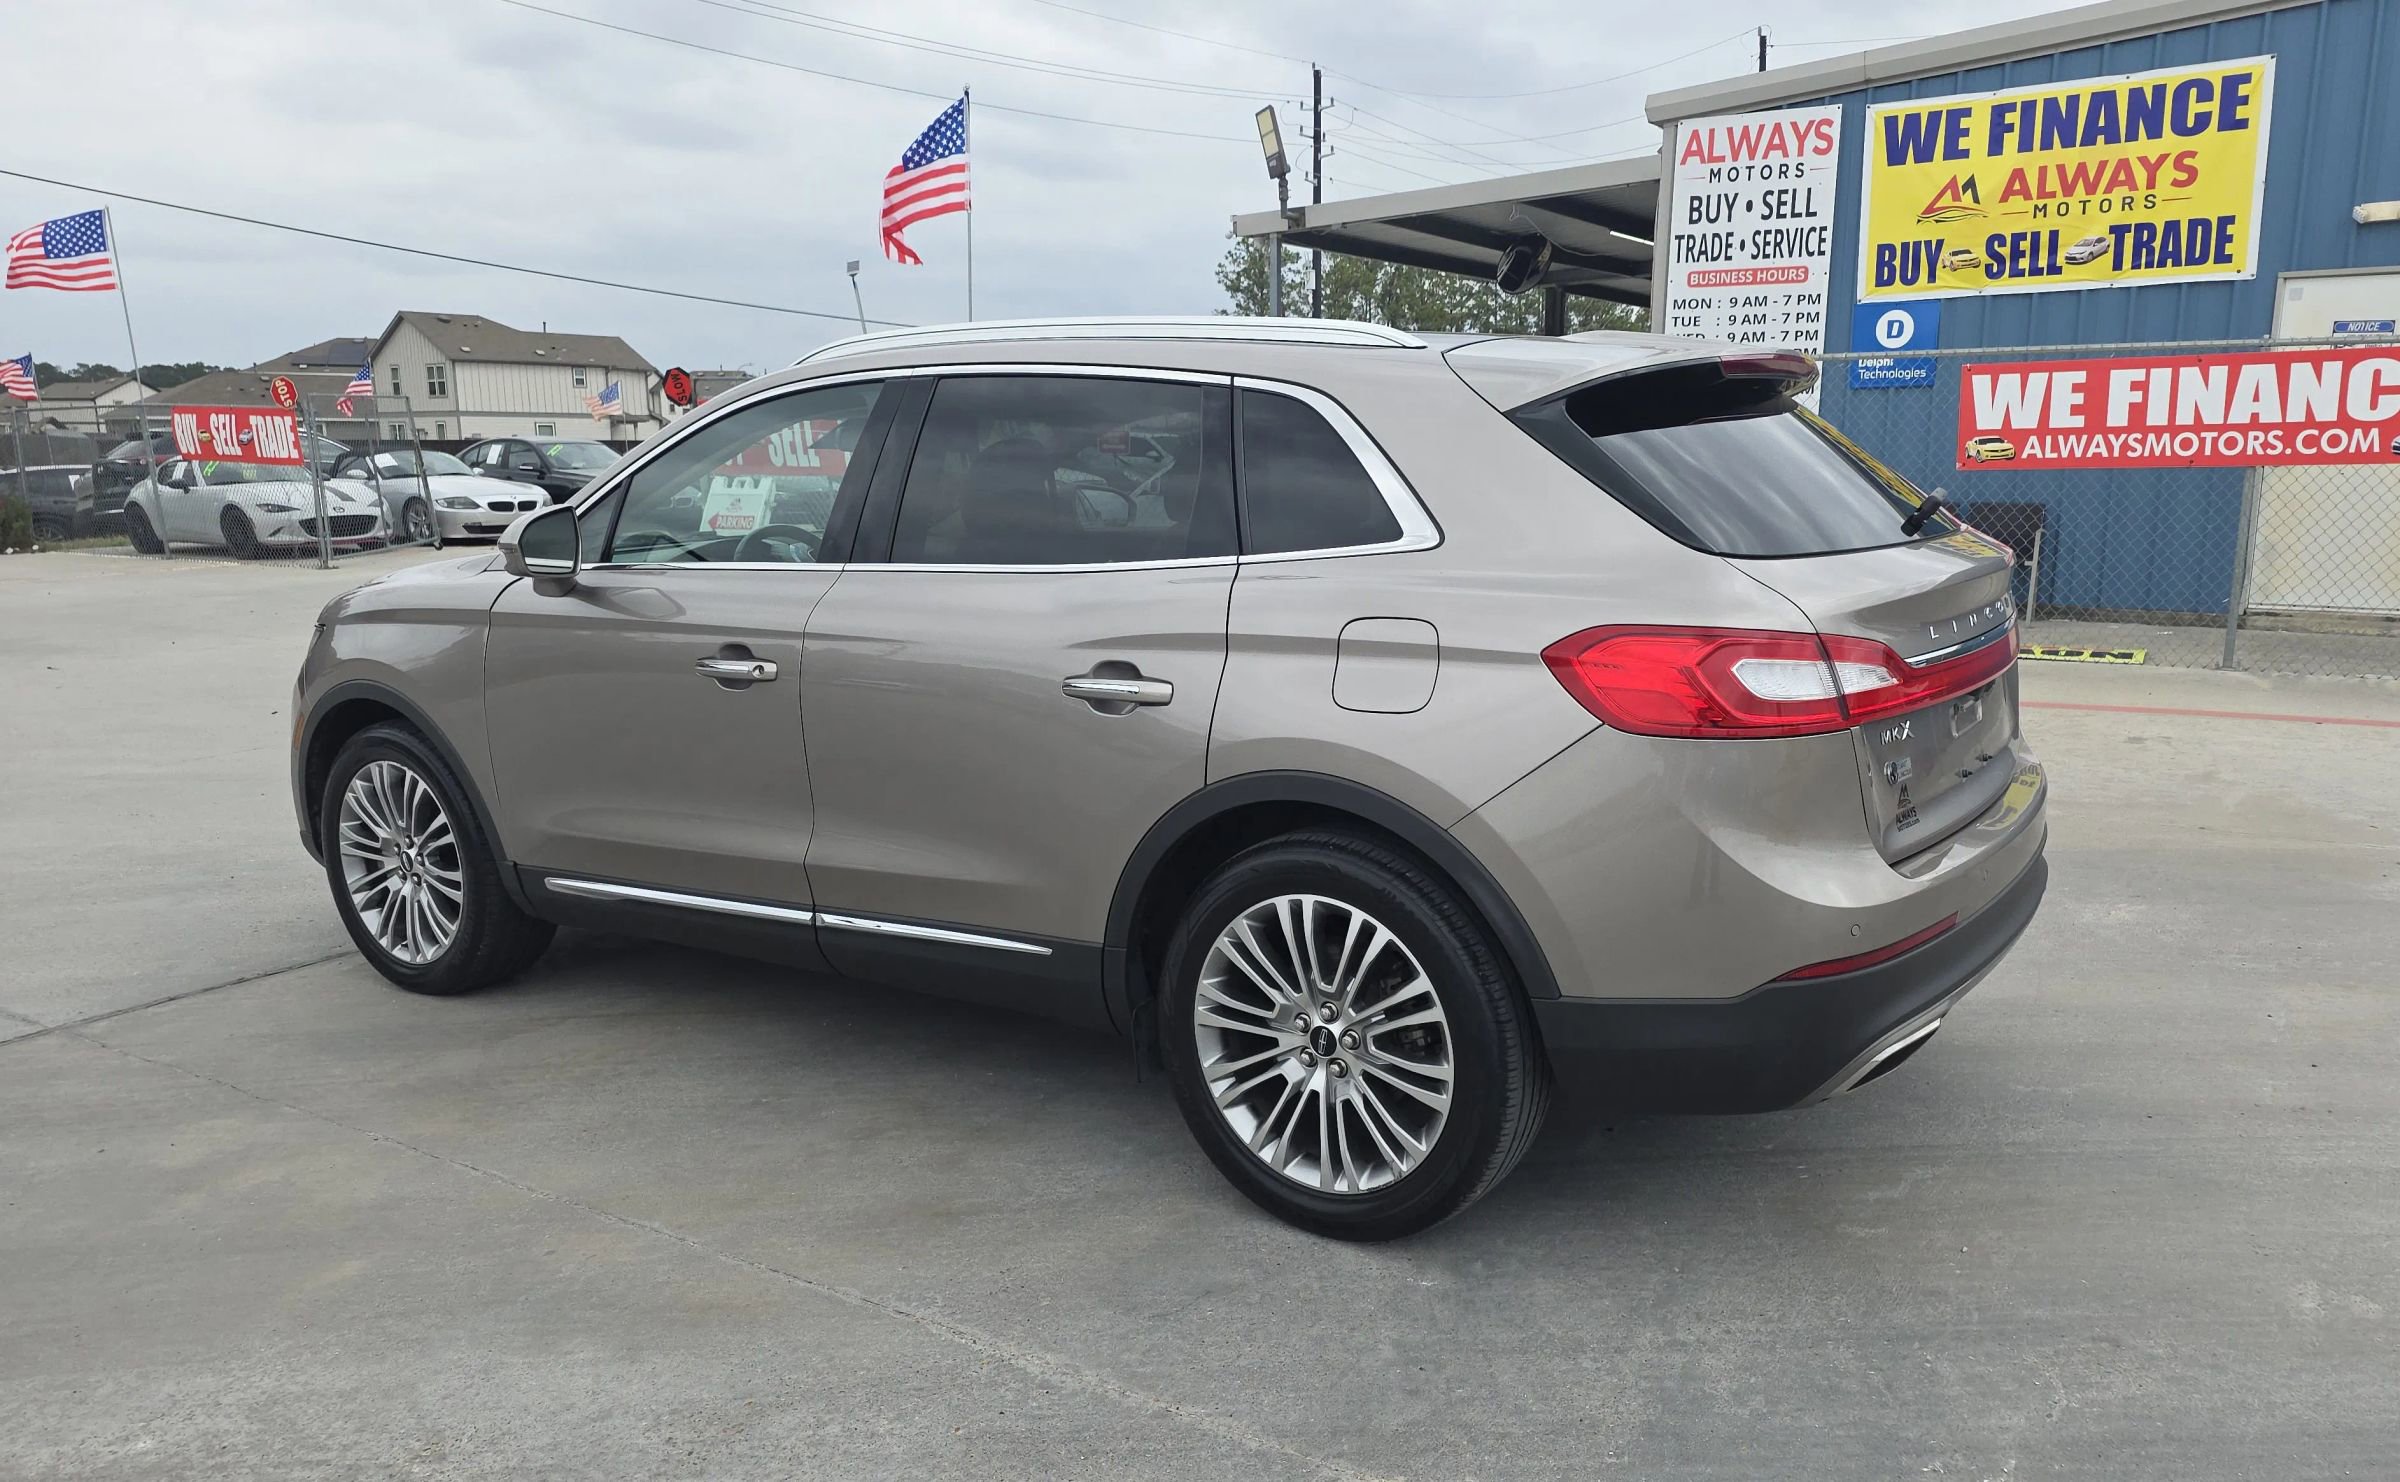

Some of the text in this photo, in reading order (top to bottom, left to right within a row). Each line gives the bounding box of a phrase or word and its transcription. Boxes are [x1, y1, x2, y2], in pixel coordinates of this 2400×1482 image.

[1883, 72, 2253, 167] WE FINANCE
[1680, 118, 1834, 166] ALWAYS
[1709, 162, 1805, 183] MOTORS
[1998, 149, 2199, 203] ALWAYS
[1688, 187, 1817, 225] BUY SELL
[2032, 193, 2157, 219] MOTORS
[1675, 226, 1828, 263] TRADE SERVICE
[1875, 215, 2237, 288] BUY SELL TRADE
[1690, 268, 1805, 285] BUSINESS HOURS
[1673, 298, 1712, 310] MON
[1729, 297, 1738, 308] 9
[1742, 295, 1768, 307] AM
[1782, 295, 1792, 306] 7
[1797, 293, 1822, 306] PM
[1671, 315, 1702, 327] TUE
[1728, 314, 1737, 326] 9
[1741, 313, 1767, 325] AM
[1781, 313, 1791, 324] 7
[1795, 311, 1820, 323] PM
[2347, 321, 2381, 332] NOTICE
[1727, 332, 1736, 343] 9
[1740, 331, 1766, 343] AM
[1780, 330, 1790, 342] 7
[1794, 329, 1819, 342] PM
[671, 373, 688, 402] SLOW
[1858, 368, 1927, 380] Technologies
[275, 380, 293, 408] STOP
[1971, 358, 2400, 431] WE FINANC
[173, 412, 300, 459] BUY SELL TRADE
[2021, 427, 2381, 459] ALWAYSMOTORS.COM
[716, 515, 754, 529] PARKING
[1880, 720, 1915, 745] MKX
[1896, 806, 1917, 825] ALWAYS
